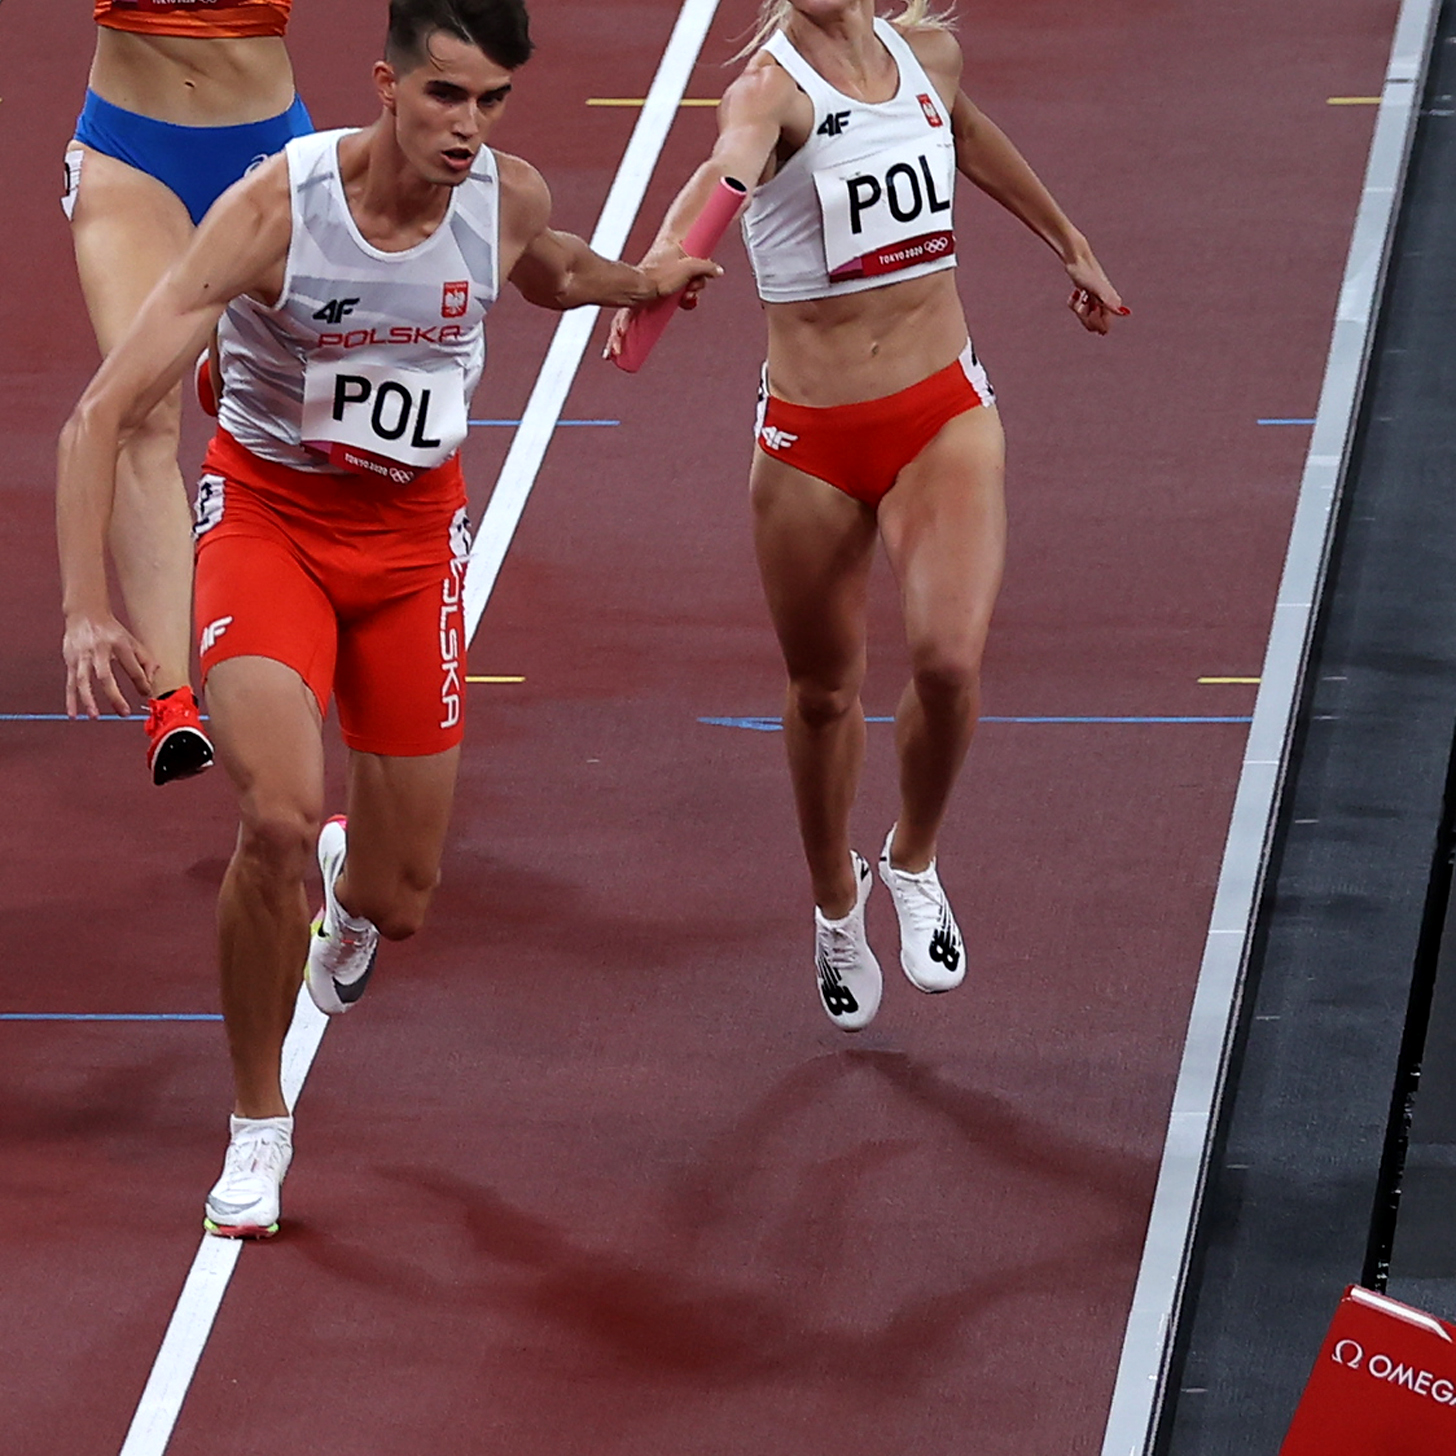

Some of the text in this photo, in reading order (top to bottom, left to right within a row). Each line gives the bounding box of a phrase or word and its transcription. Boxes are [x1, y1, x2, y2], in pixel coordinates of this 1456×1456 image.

[816, 110, 852, 137] 4F
[846, 154, 951, 235] POL
[879, 246, 924, 265] TOKYO 2020
[312, 297, 360, 324] 4F
[317, 324, 461, 349] POLSKA
[332, 374, 442, 448] POL
[344, 452, 369, 471] TOKYO
